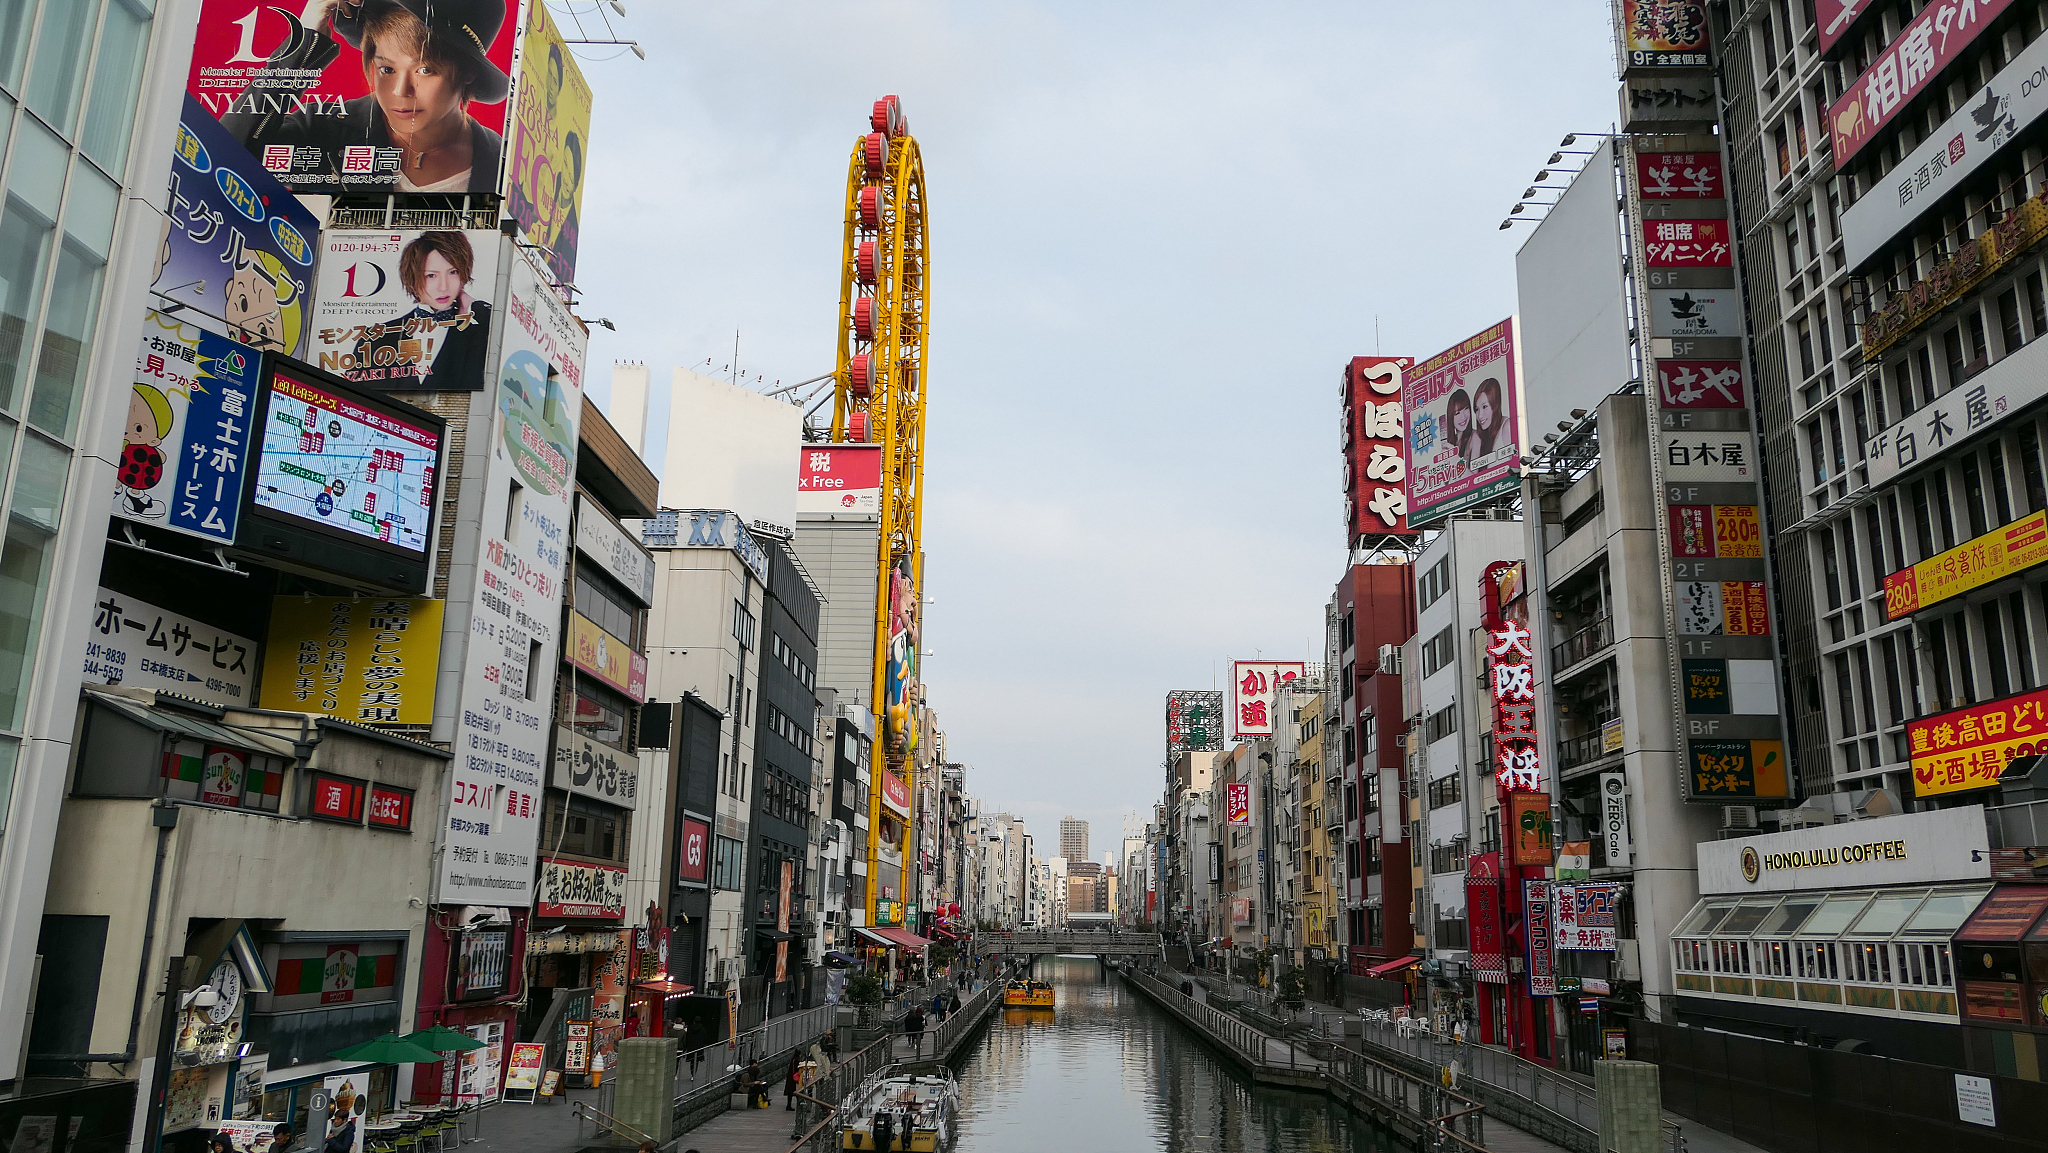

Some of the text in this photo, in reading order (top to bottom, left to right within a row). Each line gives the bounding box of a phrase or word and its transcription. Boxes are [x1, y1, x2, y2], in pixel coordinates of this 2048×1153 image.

[1633, 51, 1708, 66] 9F 全室個室
[199, 79, 322, 89] DEEP GROUP
[200, 67, 322, 78] Monster Entertainment
[199, 92, 350, 116] NYANNYA
[342, 146, 403, 173] 最高
[1898, 148, 1949, 208] 居酒家
[224, 172, 256, 218] リフォーム
[1656, 223, 1693, 242] 相席
[331, 243, 400, 253] 0120-194-373
[1646, 242, 1730, 264] ダイニング
[318, 312, 475, 345] モンスターグループ
[1672, 328, 1718, 336] DOMA-DOMA
[391, 365, 434, 380] RUKA
[1660, 366, 1741, 406] はや
[1870, 384, 1992, 469] 4F 白木屋
[200, 387, 248, 535] 富士ホーム
[810, 452, 830, 472] 税
[1668, 440, 1746, 466] 白木屋
[179, 442, 208, 520] サービス
[812, 476, 844, 488] Free
[1718, 506, 1753, 518] 全品
[1716, 518, 1760, 542] 280円
[1944, 542, 1988, 585] 鳥貴族
[1886, 582, 1917, 612] 280円
[321, 602, 352, 711] あなたのお店づくり
[357, 600, 411, 723] 素晴らしい夢の実現
[632, 654, 646, 675] 17:00
[140, 658, 242, 698] 日本橋支店 4396-7000
[292, 640, 322, 702] 応援します
[1690, 674, 1720, 688] びっくり
[1486, 619, 1540, 792] 大阪王将
[1690, 687, 1723, 699] ドンキー
[484, 698, 500, 714] ロッジ
[515, 711, 539, 730] 3,780円
[568, 742, 619, 797] うなぎ
[1697, 751, 1744, 772] びっくり
[1936, 749, 2001, 786] 酒場
[454, 780, 494, 810] コスパ
[1697, 772, 1750, 793] ドンキー
[326, 786, 340, 811] 酒
[369, 794, 400, 818] たばこ
[1230, 790, 1238, 816] ドラッグ
[1238, 786, 1247, 810] ツルハ
[453, 846, 478, 864] 予約受付
[1764, 839, 1909, 872] HONOLULU COFFEE
[560, 866, 606, 903] お好み焼
[562, 904, 600, 916] OKONOMIYAKI
[1479, 887, 1492, 944] 大阪みやげ
[1558, 888, 1575, 926] 薬
[1531, 903, 1548, 951] ダイコク
[1576, 929, 1602, 948] 免税
[1532, 977, 1554, 987] 免税
